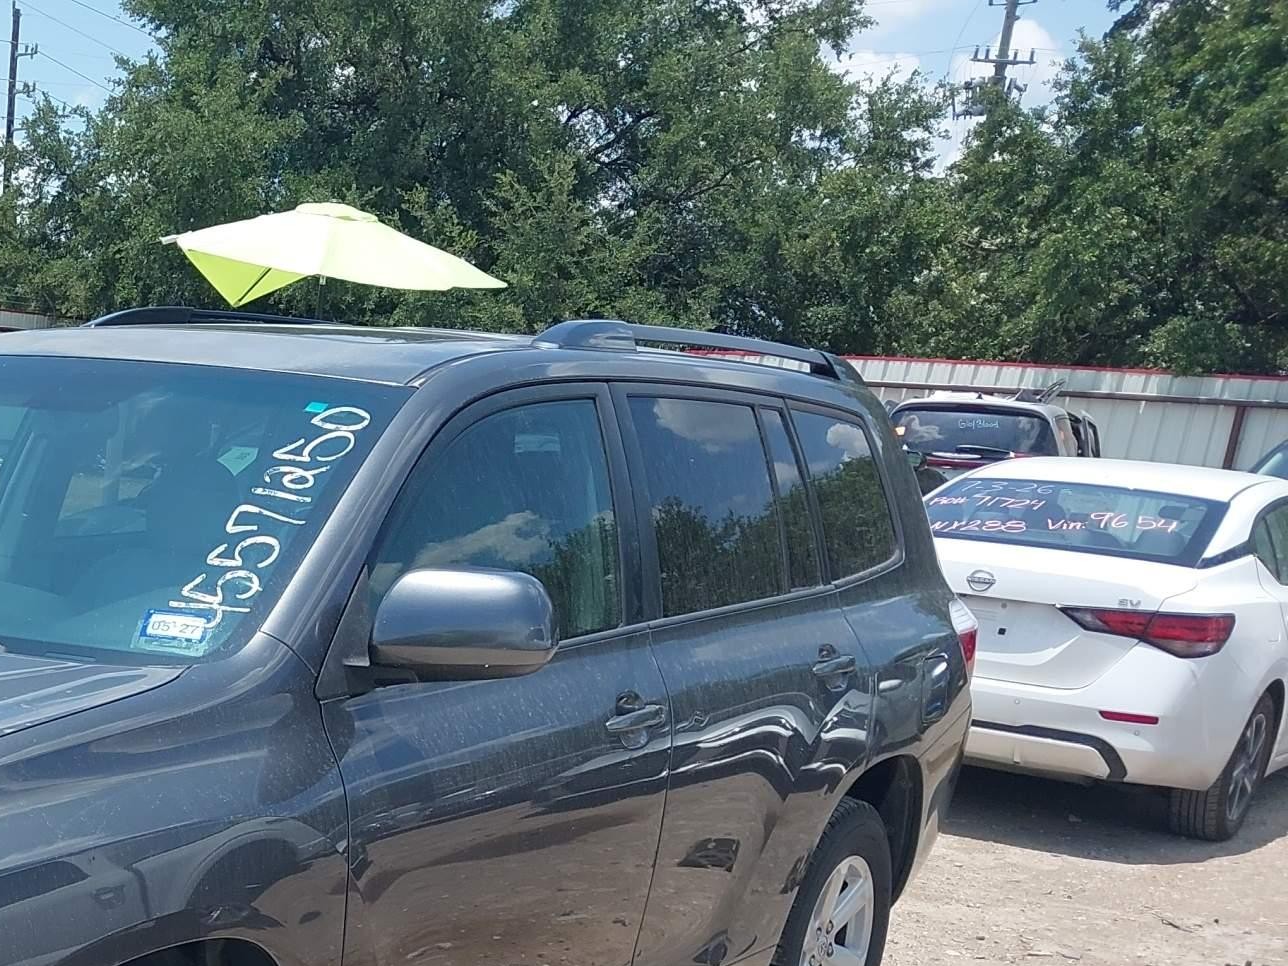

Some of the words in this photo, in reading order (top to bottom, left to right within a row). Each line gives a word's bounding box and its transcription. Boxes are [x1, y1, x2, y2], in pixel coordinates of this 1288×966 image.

[961, 480, 1056, 495] 7-3-26
[169, 406, 371, 628] 45571250
[1118, 598, 1142, 608] SV
